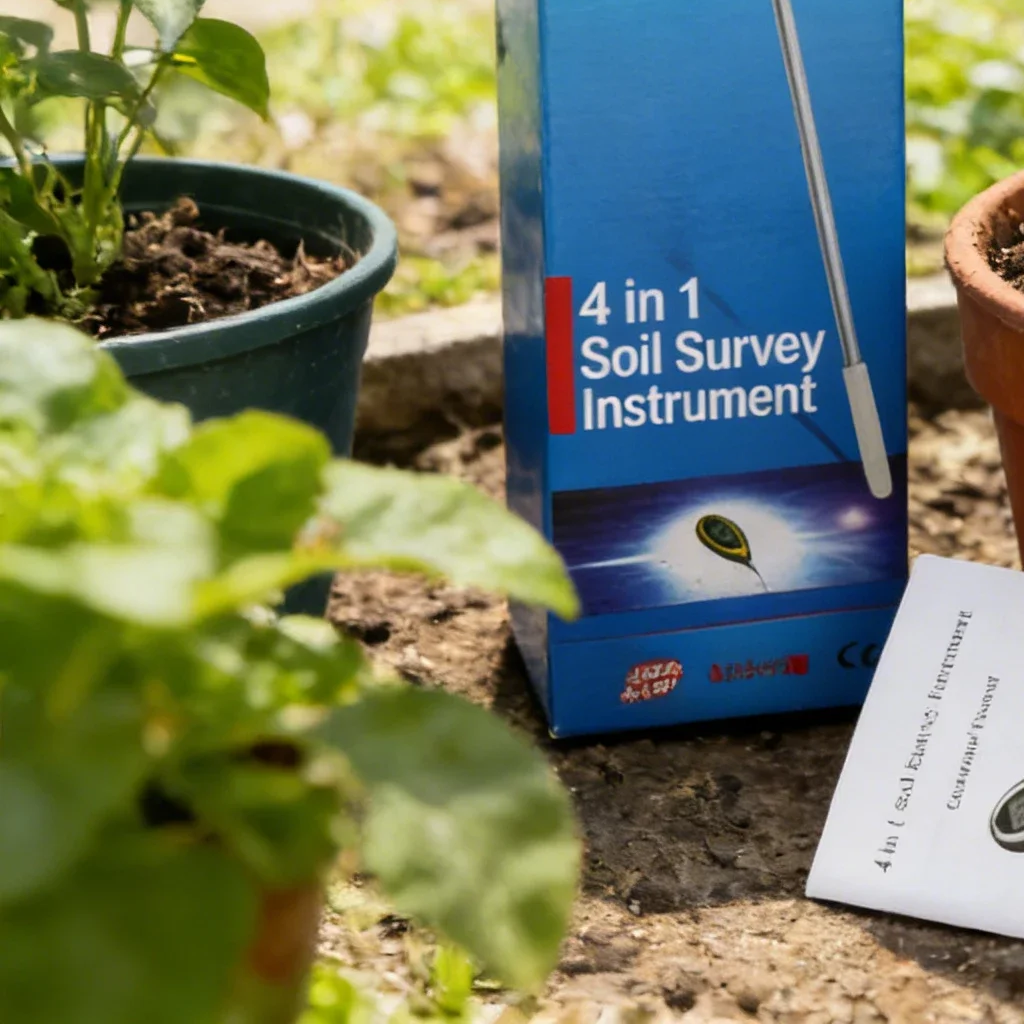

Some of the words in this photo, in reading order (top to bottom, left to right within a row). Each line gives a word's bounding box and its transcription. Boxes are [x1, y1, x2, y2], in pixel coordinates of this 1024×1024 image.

[578, 281, 611, 326] 4
[625, 278, 665, 324] in
[679, 276, 700, 319] 1
[580, 330, 662, 380] Soil
[675, 330, 826, 373] Survey
[583, 374, 818, 431] Instrument
